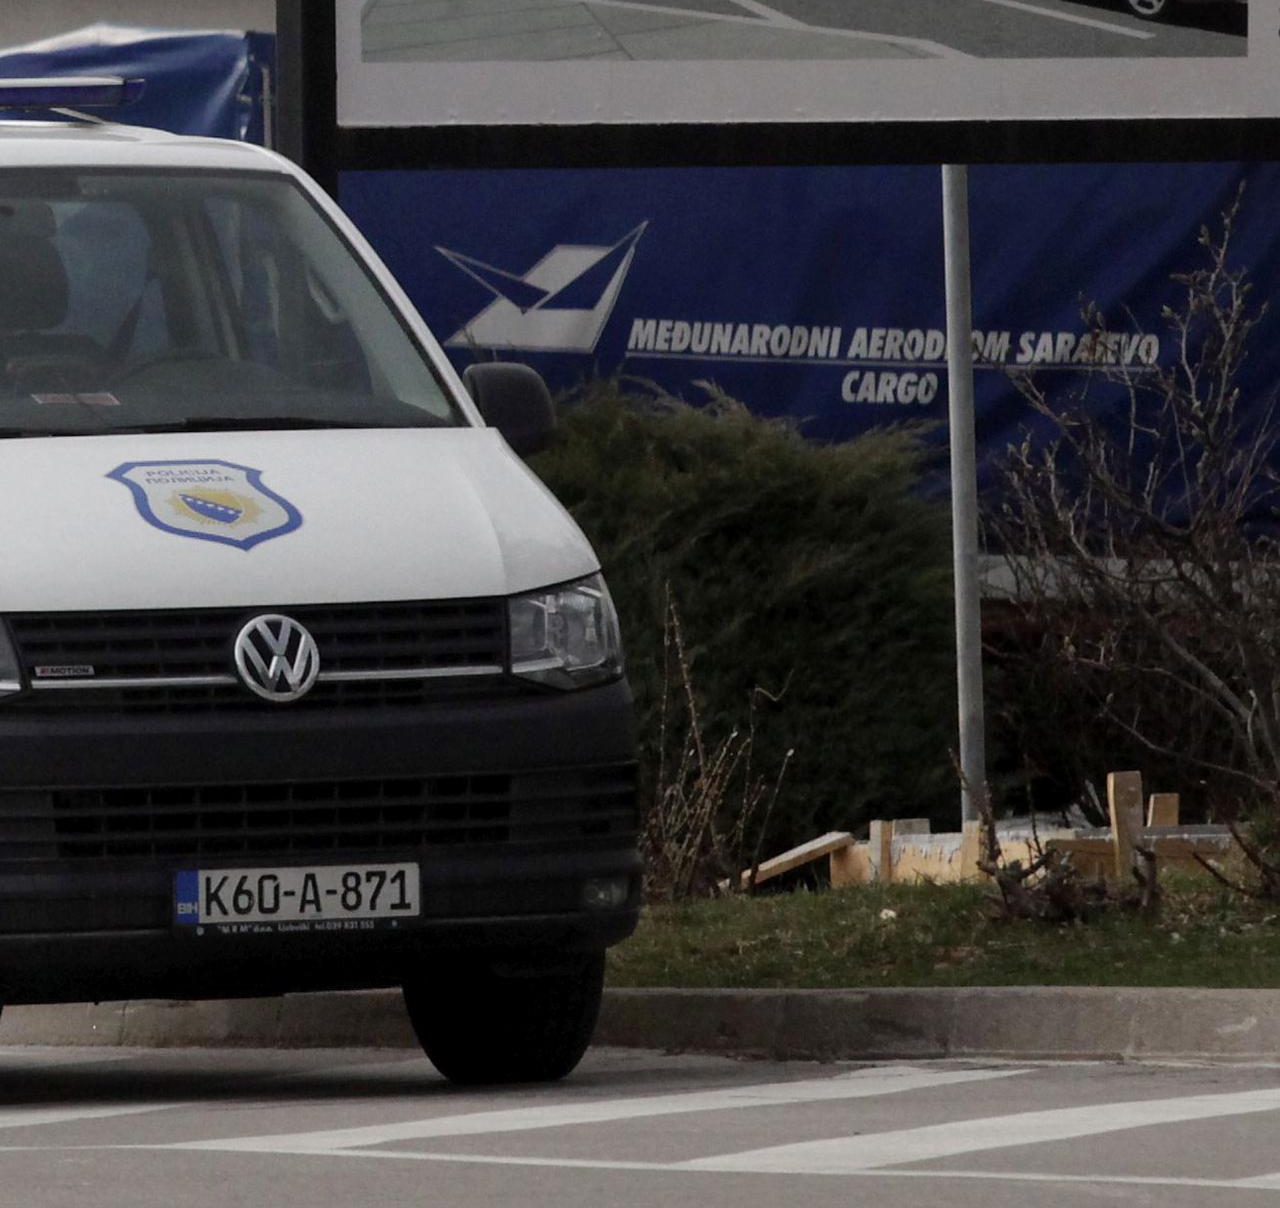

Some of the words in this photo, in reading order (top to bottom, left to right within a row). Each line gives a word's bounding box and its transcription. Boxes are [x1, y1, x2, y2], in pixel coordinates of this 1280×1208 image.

[847, 327, 1011, 362] AERODOM
[841, 370, 939, 405] CARGO
[204, 869, 412, 917] K60-A-871
